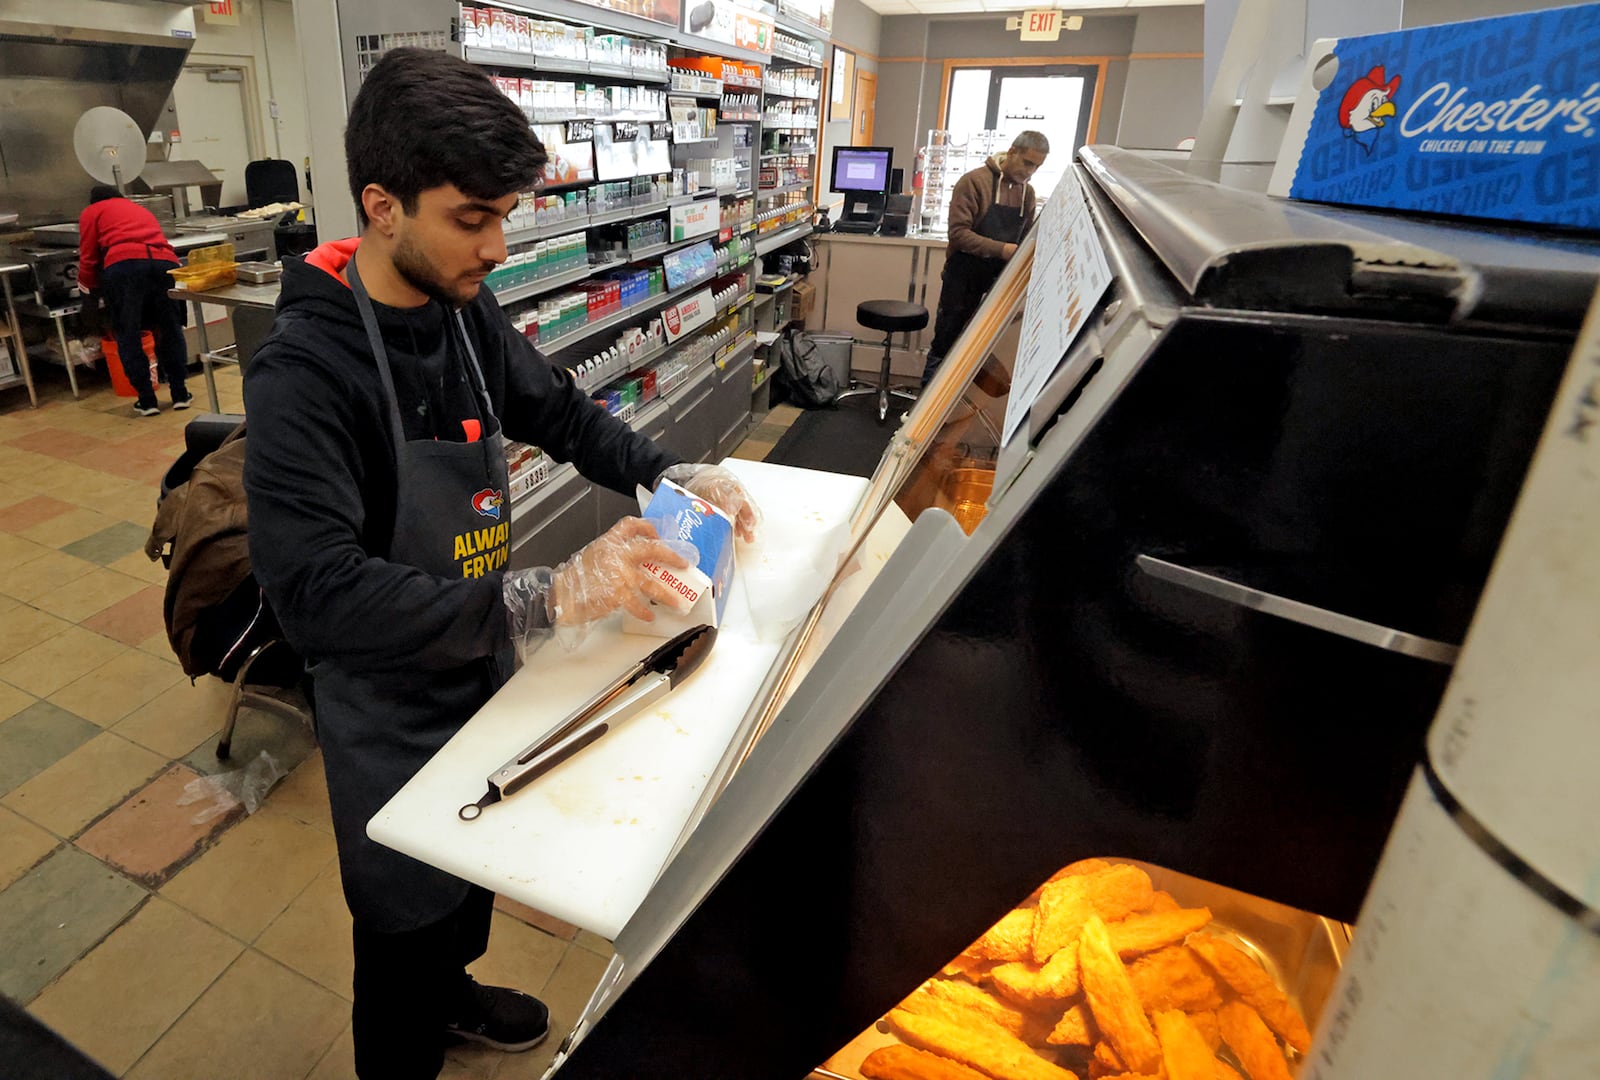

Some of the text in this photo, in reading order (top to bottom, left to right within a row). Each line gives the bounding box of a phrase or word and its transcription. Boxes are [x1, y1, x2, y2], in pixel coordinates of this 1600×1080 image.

[1029, 13, 1056, 32] EXIT
[1400, 81, 1600, 138] Chester's
[1419, 139, 1547, 155] CHICKEN ON THE RUN
[659, 568, 699, 602] BREADED
